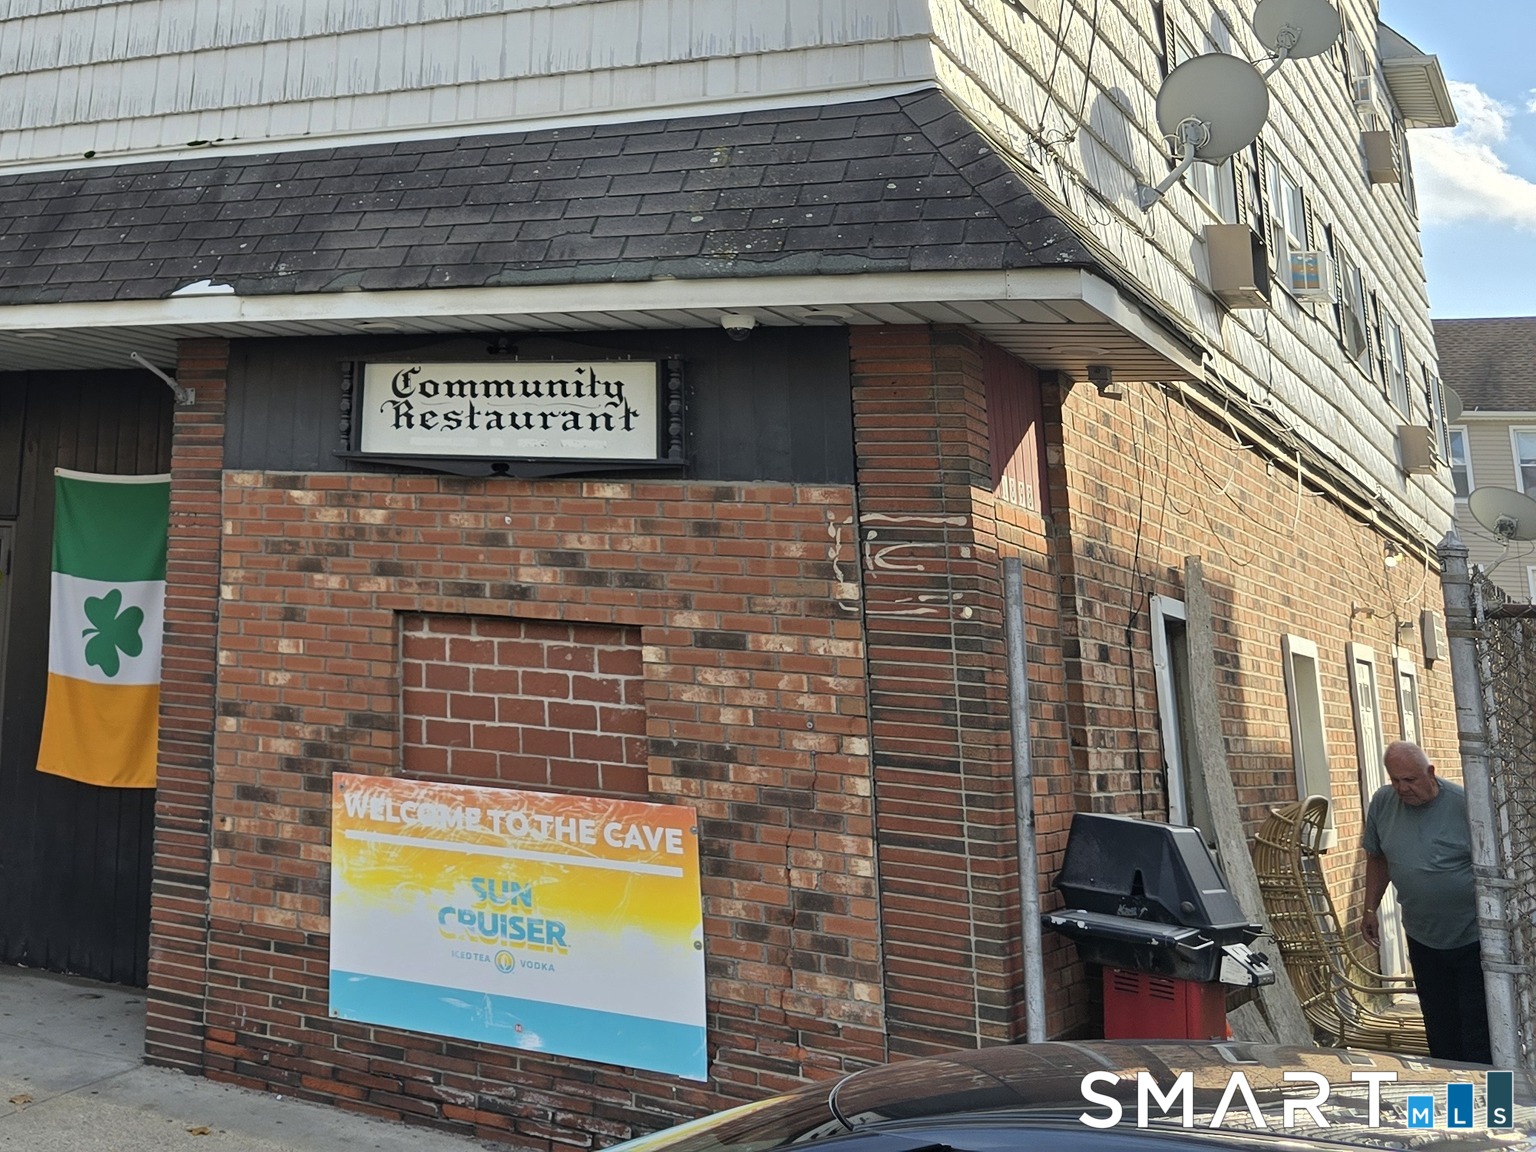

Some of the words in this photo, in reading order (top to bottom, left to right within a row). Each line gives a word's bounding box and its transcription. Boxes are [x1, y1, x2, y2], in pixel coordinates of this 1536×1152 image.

[391, 365, 626, 407] Community
[380, 397, 640, 432] Restaurant
[344, 791, 481, 831] WELCOME
[487, 809, 529, 838] TO
[532, 814, 597, 845] THE
[604, 822, 684, 855] CAVE
[471, 877, 532, 908] SUN
[438, 906, 568, 949] CRUISER
[451, 950, 473, 960] ICED
[473, 953, 491, 963] TEA
[520, 959, 555, 972] VODKA
